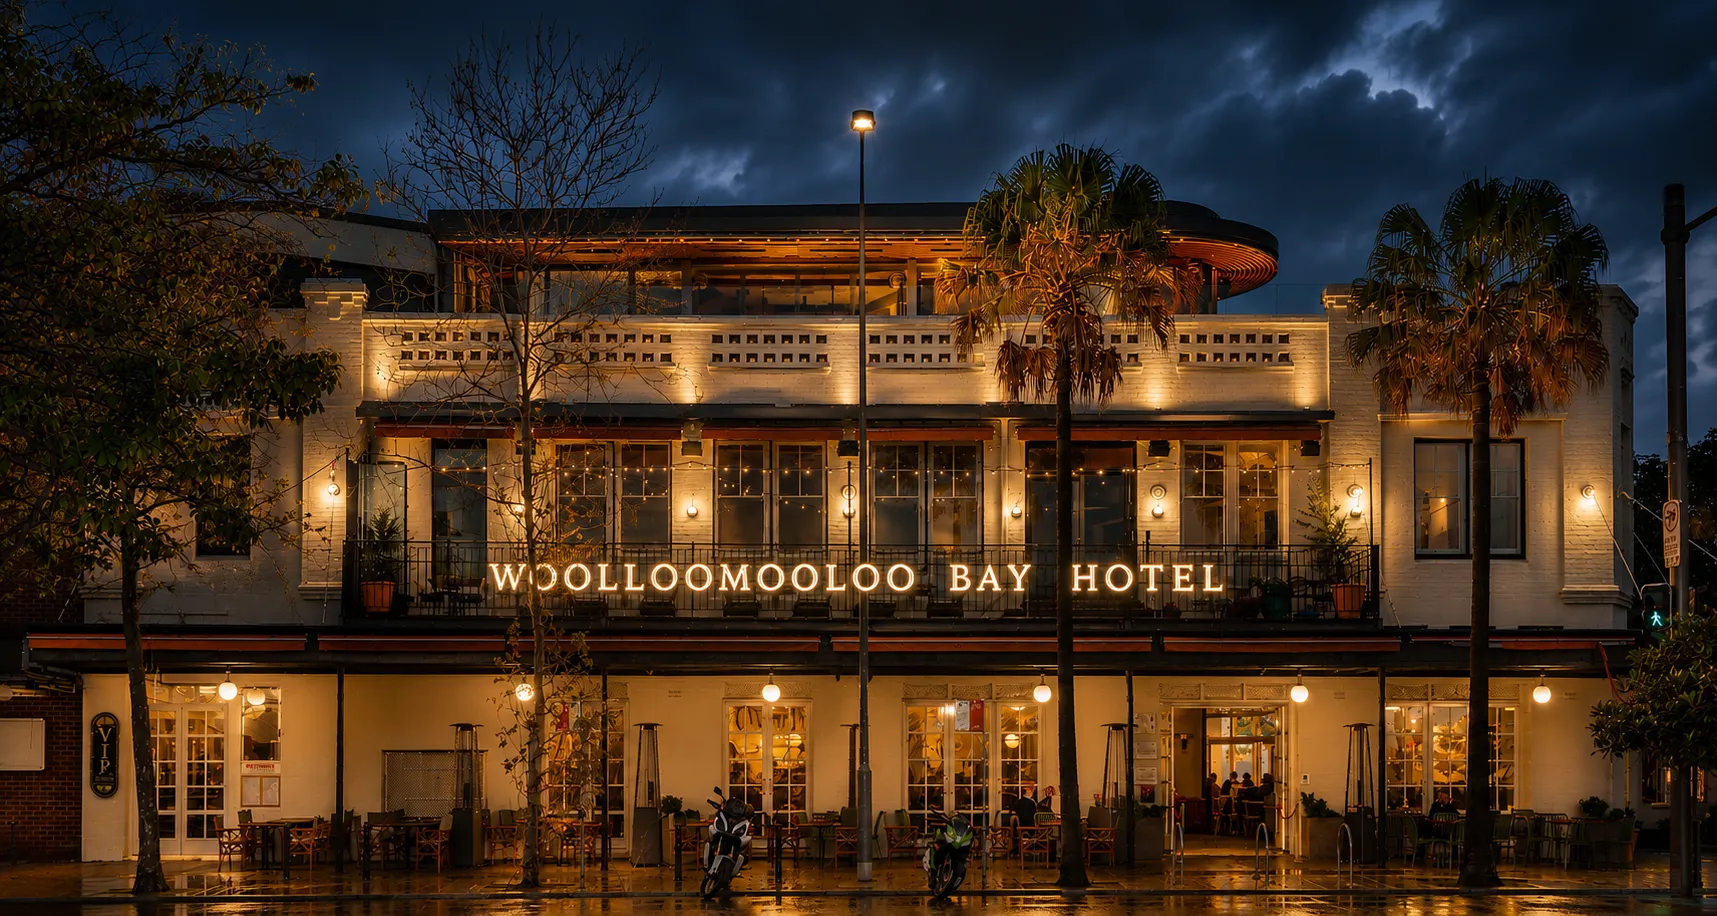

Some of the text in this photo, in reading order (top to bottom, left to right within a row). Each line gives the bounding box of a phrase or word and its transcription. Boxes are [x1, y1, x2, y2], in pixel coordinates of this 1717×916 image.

[488, 563, 1223, 592] WOOLLOOMOOLOO BAY HOTEL
